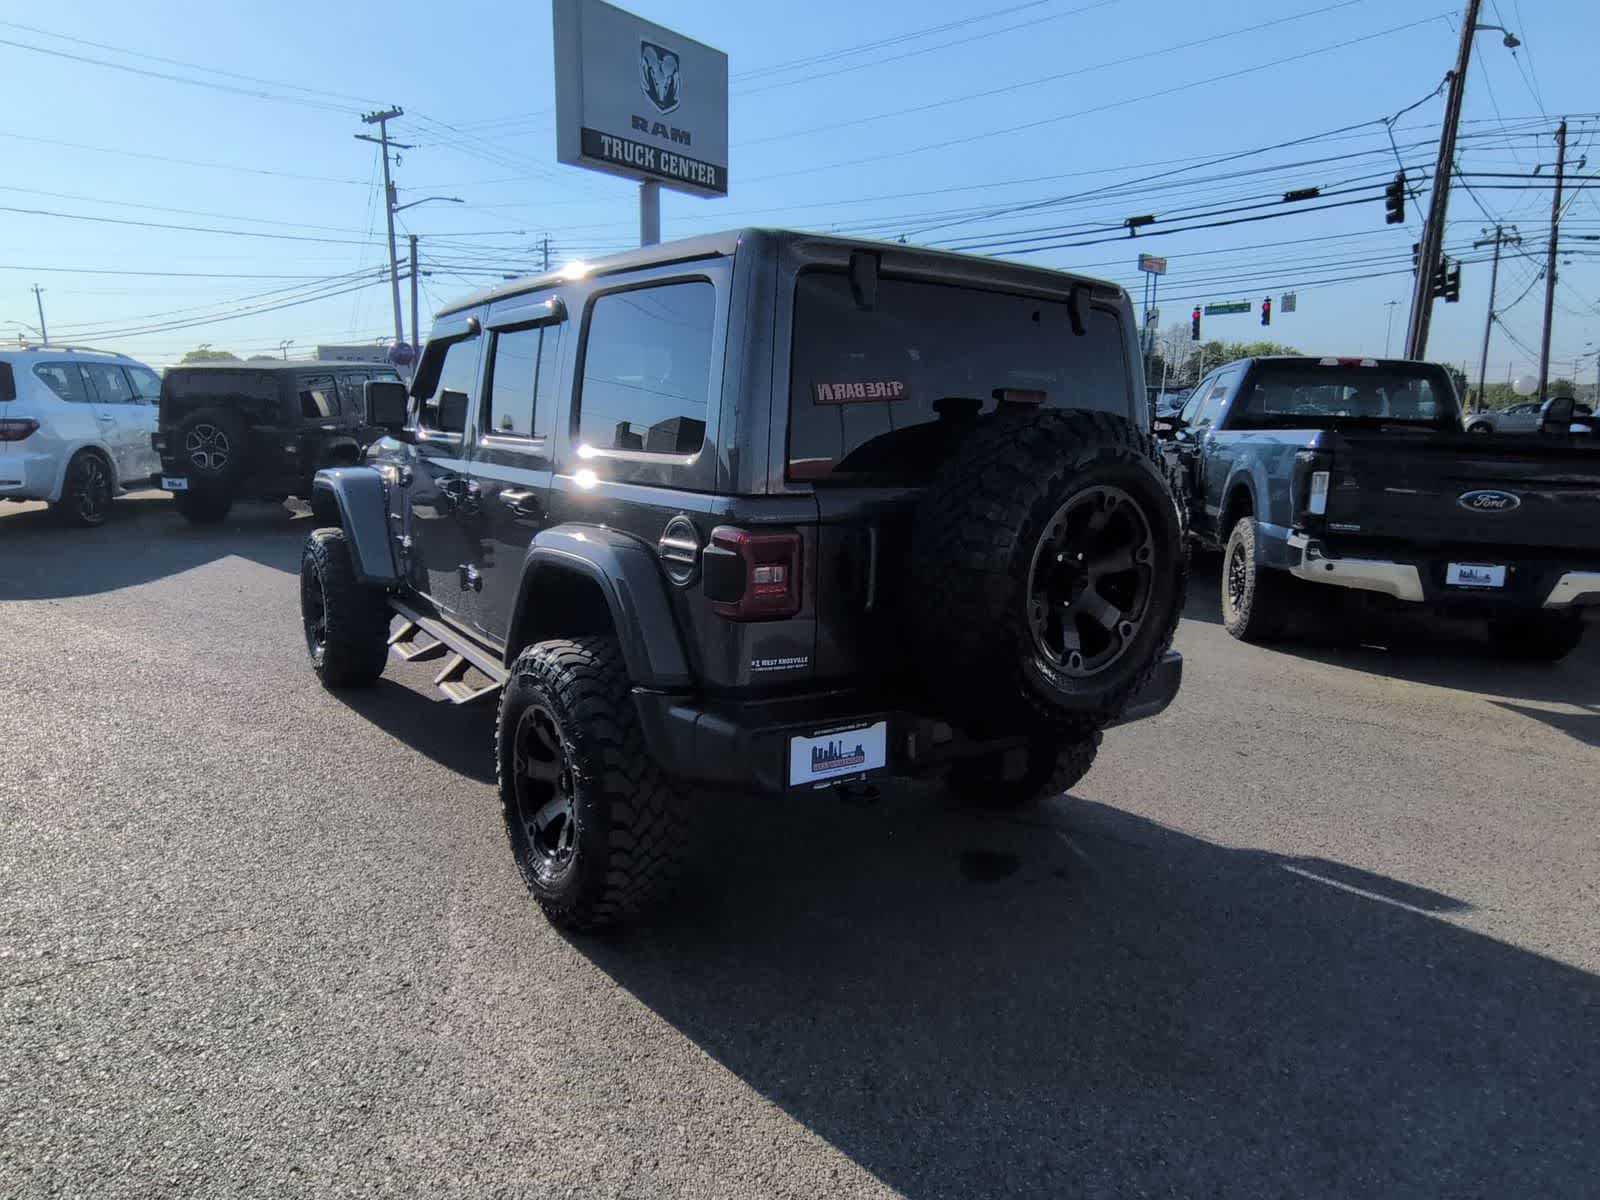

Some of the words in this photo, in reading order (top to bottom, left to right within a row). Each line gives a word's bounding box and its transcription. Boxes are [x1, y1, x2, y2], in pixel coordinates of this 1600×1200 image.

[631, 115, 692, 146] RAM
[600, 135, 655, 169] TRUCK
[660, 153, 716, 185] CENTER
[1472, 494, 1509, 508] Ford
[778, 656, 808, 665] KNOXVILLE
